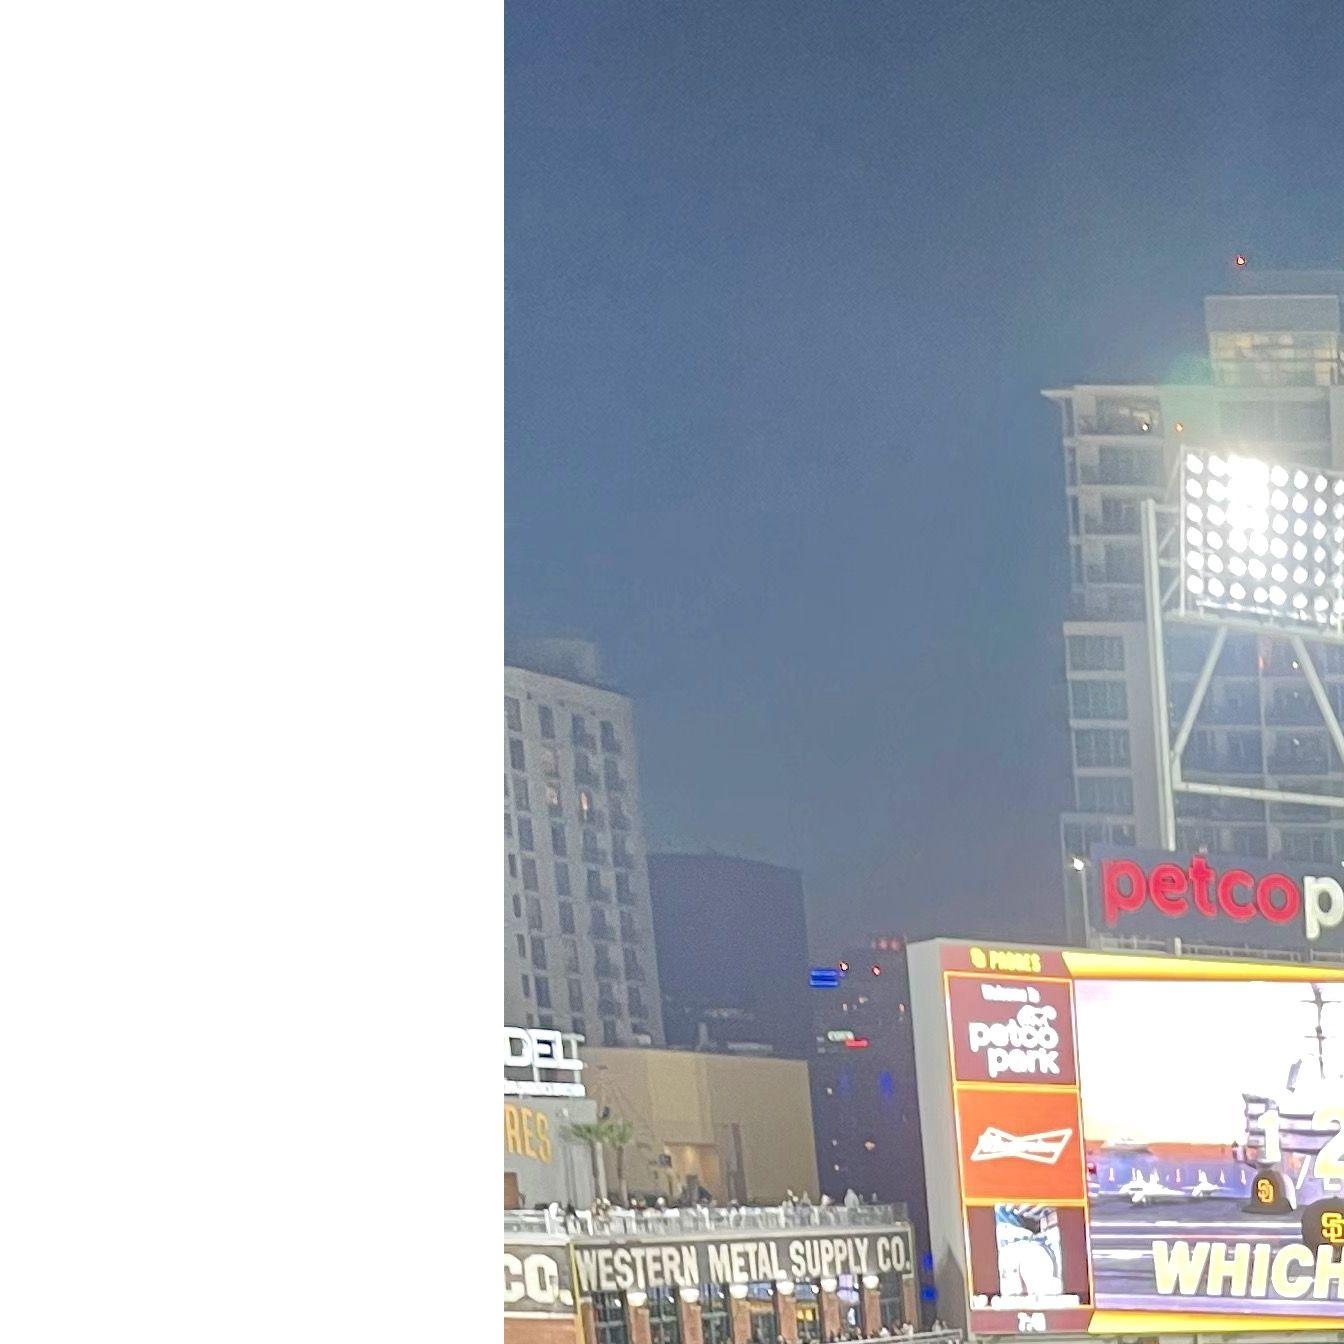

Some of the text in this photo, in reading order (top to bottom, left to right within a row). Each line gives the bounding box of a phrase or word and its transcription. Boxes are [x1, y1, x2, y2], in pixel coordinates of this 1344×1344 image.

[1103, 855, 1300, 928] petco
[575, 1236, 910, 1291] WESTERN METAL SUPPLY CO.
